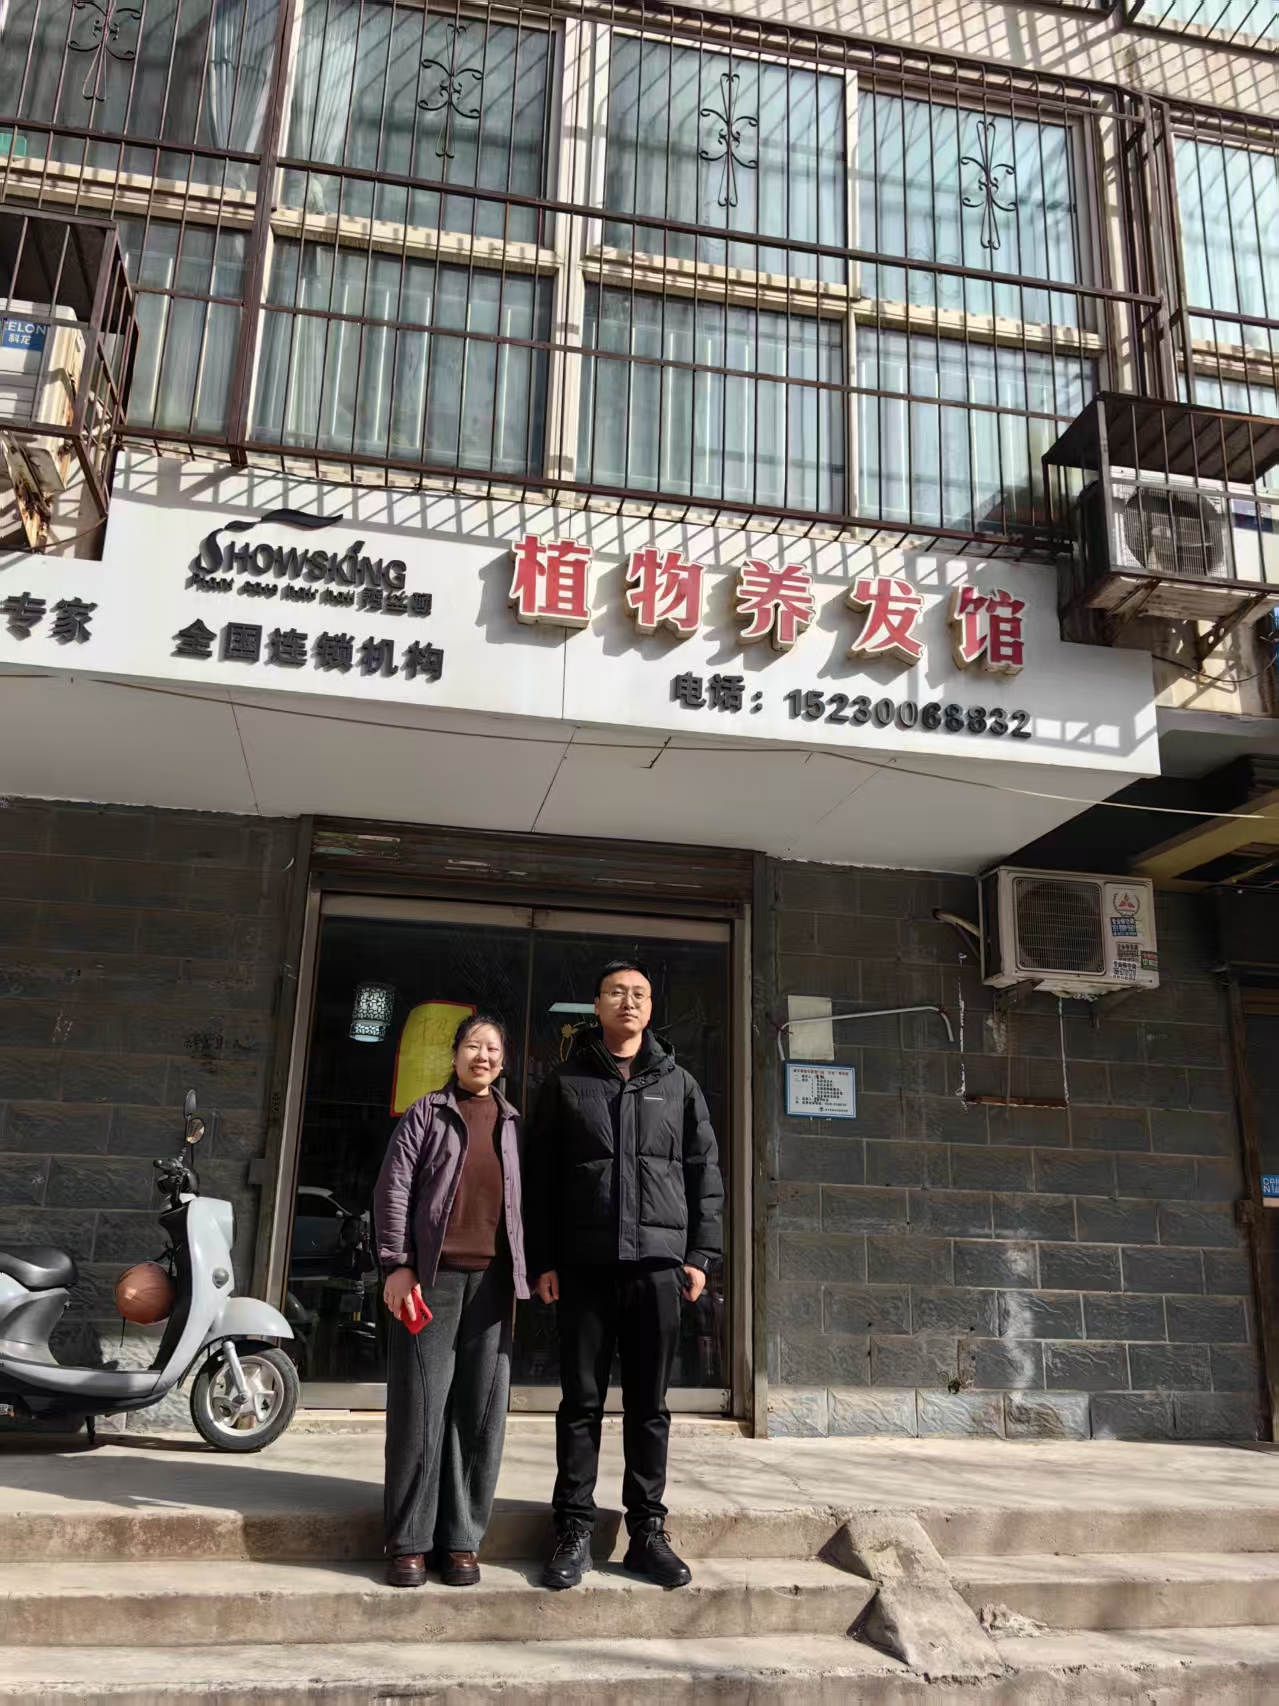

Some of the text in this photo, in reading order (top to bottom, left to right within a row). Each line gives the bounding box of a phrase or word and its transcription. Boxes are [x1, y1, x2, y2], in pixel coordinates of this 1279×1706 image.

[3, 320, 46, 335] ELON
[188, 528, 408, 592] SHOWSKING
[0, 591, 98, 645] 专家
[508, 533, 1026, 675] 植物养发馆
[171, 618, 445, 683] 全国连锁机构
[785, 688, 1032, 738] 15230068832
